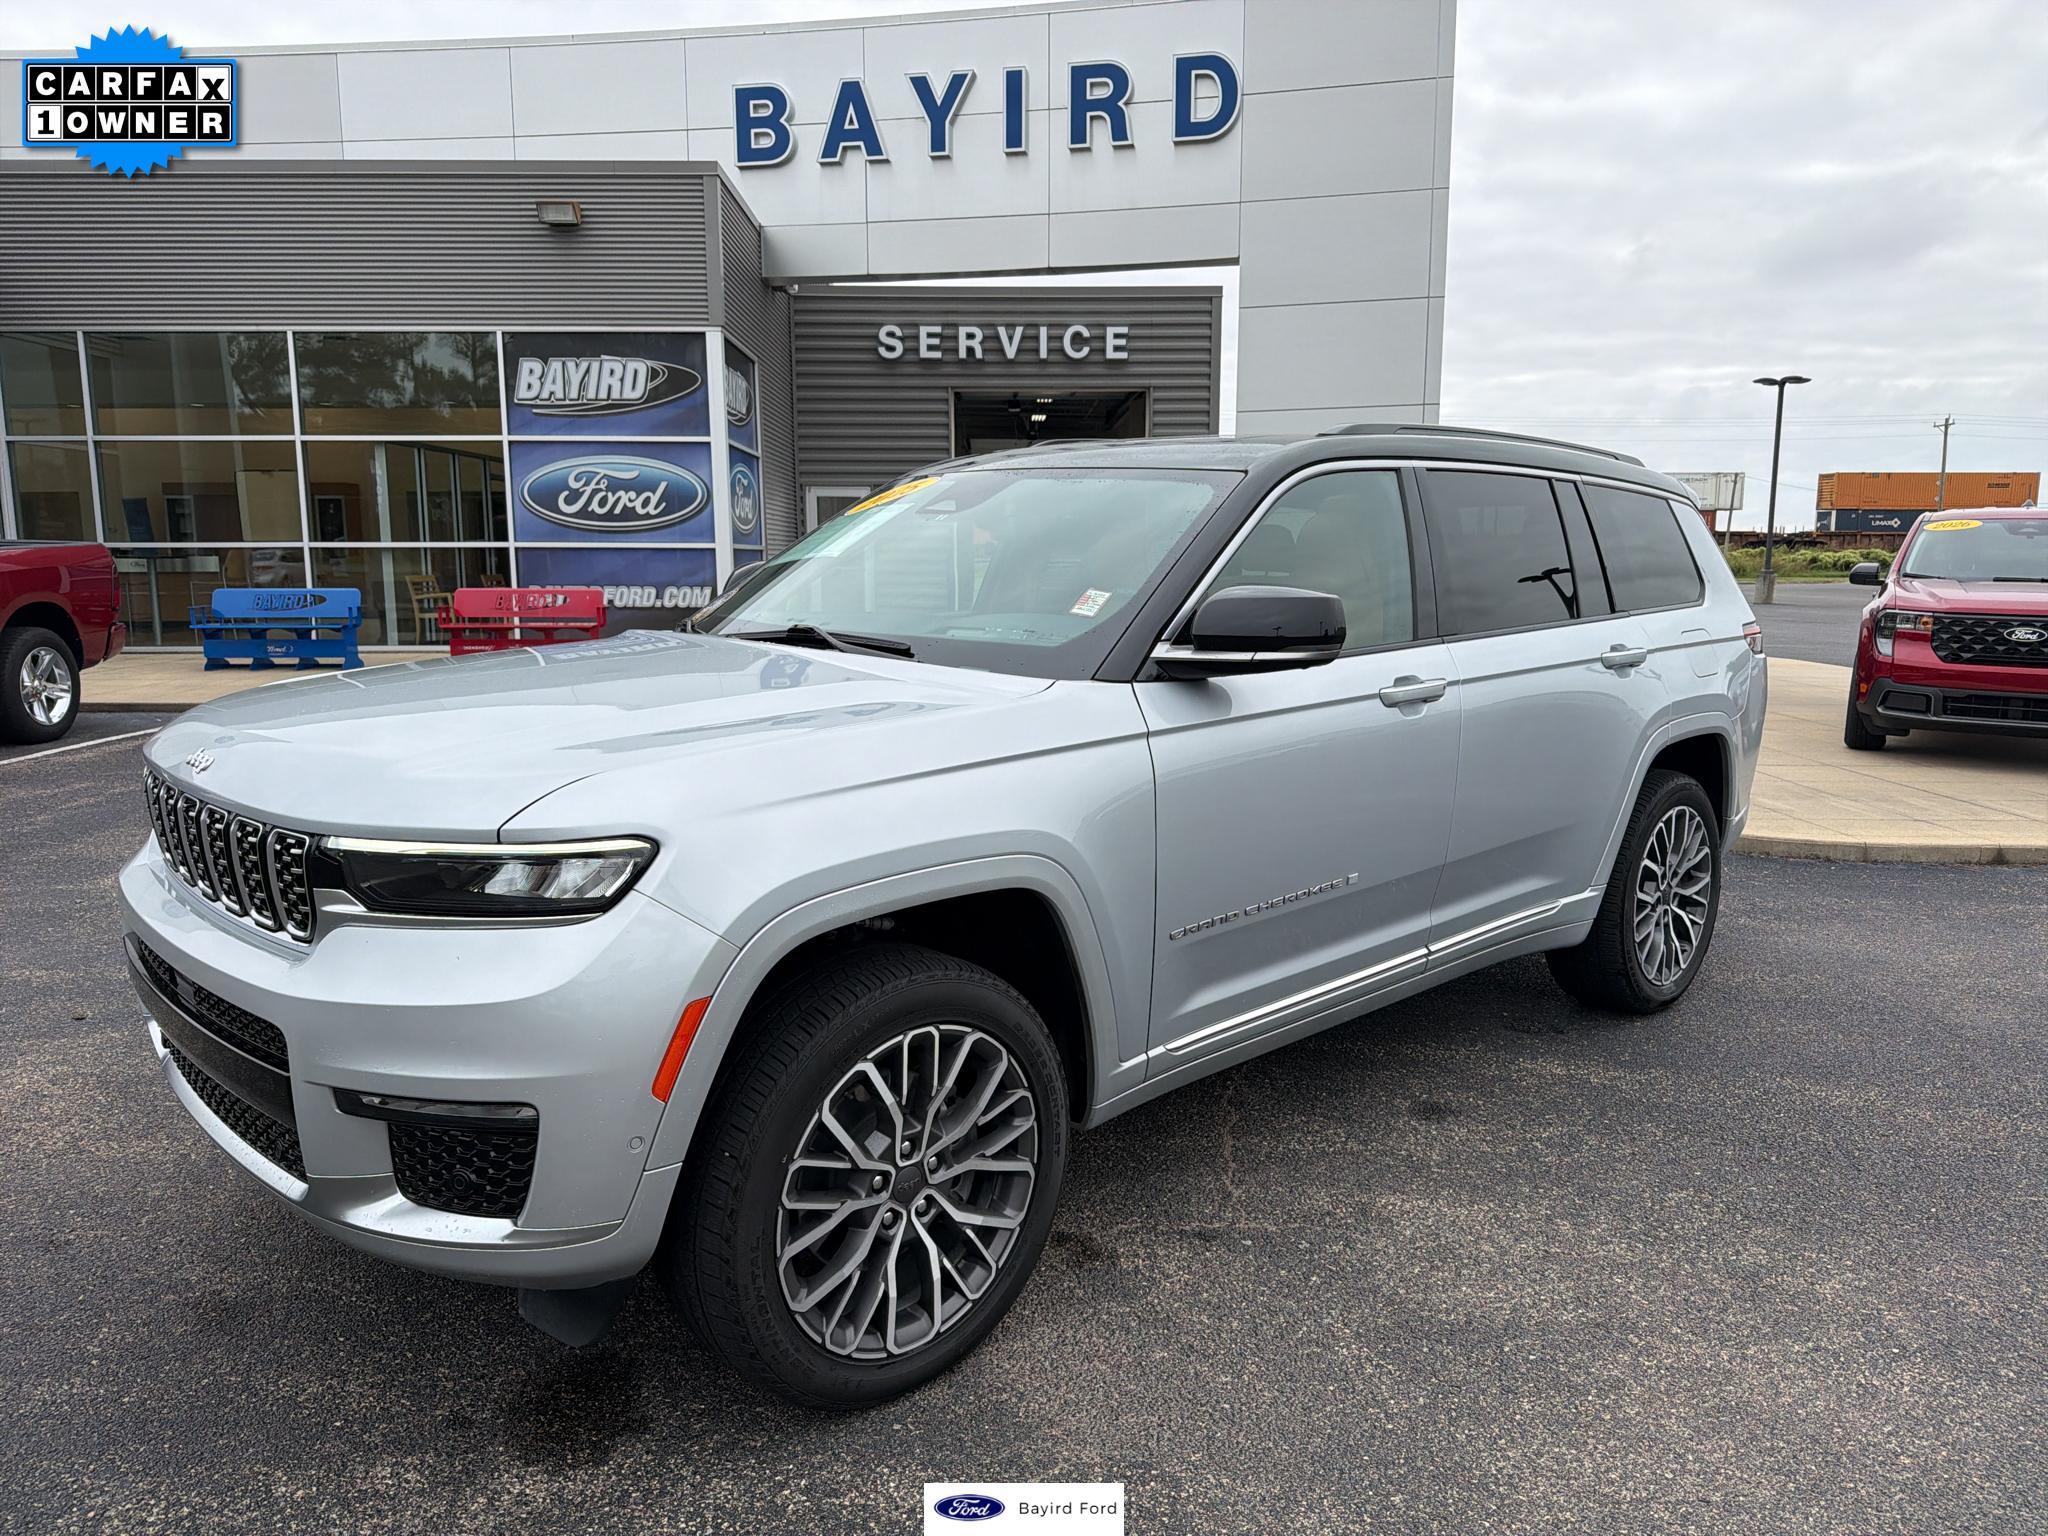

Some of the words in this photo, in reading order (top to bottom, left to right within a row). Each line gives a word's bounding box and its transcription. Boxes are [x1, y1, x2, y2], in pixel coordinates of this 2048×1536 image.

[731, 50, 1243, 168] BAYIRD
[878, 324, 1129, 360] SERVICE
[514, 357, 650, 404] BAYIRD
[557, 465, 669, 516] Ford
[734, 474, 754, 520] Ford
[1933, 521, 1972, 530] 2026
[252, 593, 303, 609] BAYIRD
[2011, 629, 2040, 640] Ford
[1169, 909, 1240, 941] GRAND
[1244, 878, 1343, 917] CHEROKEE
